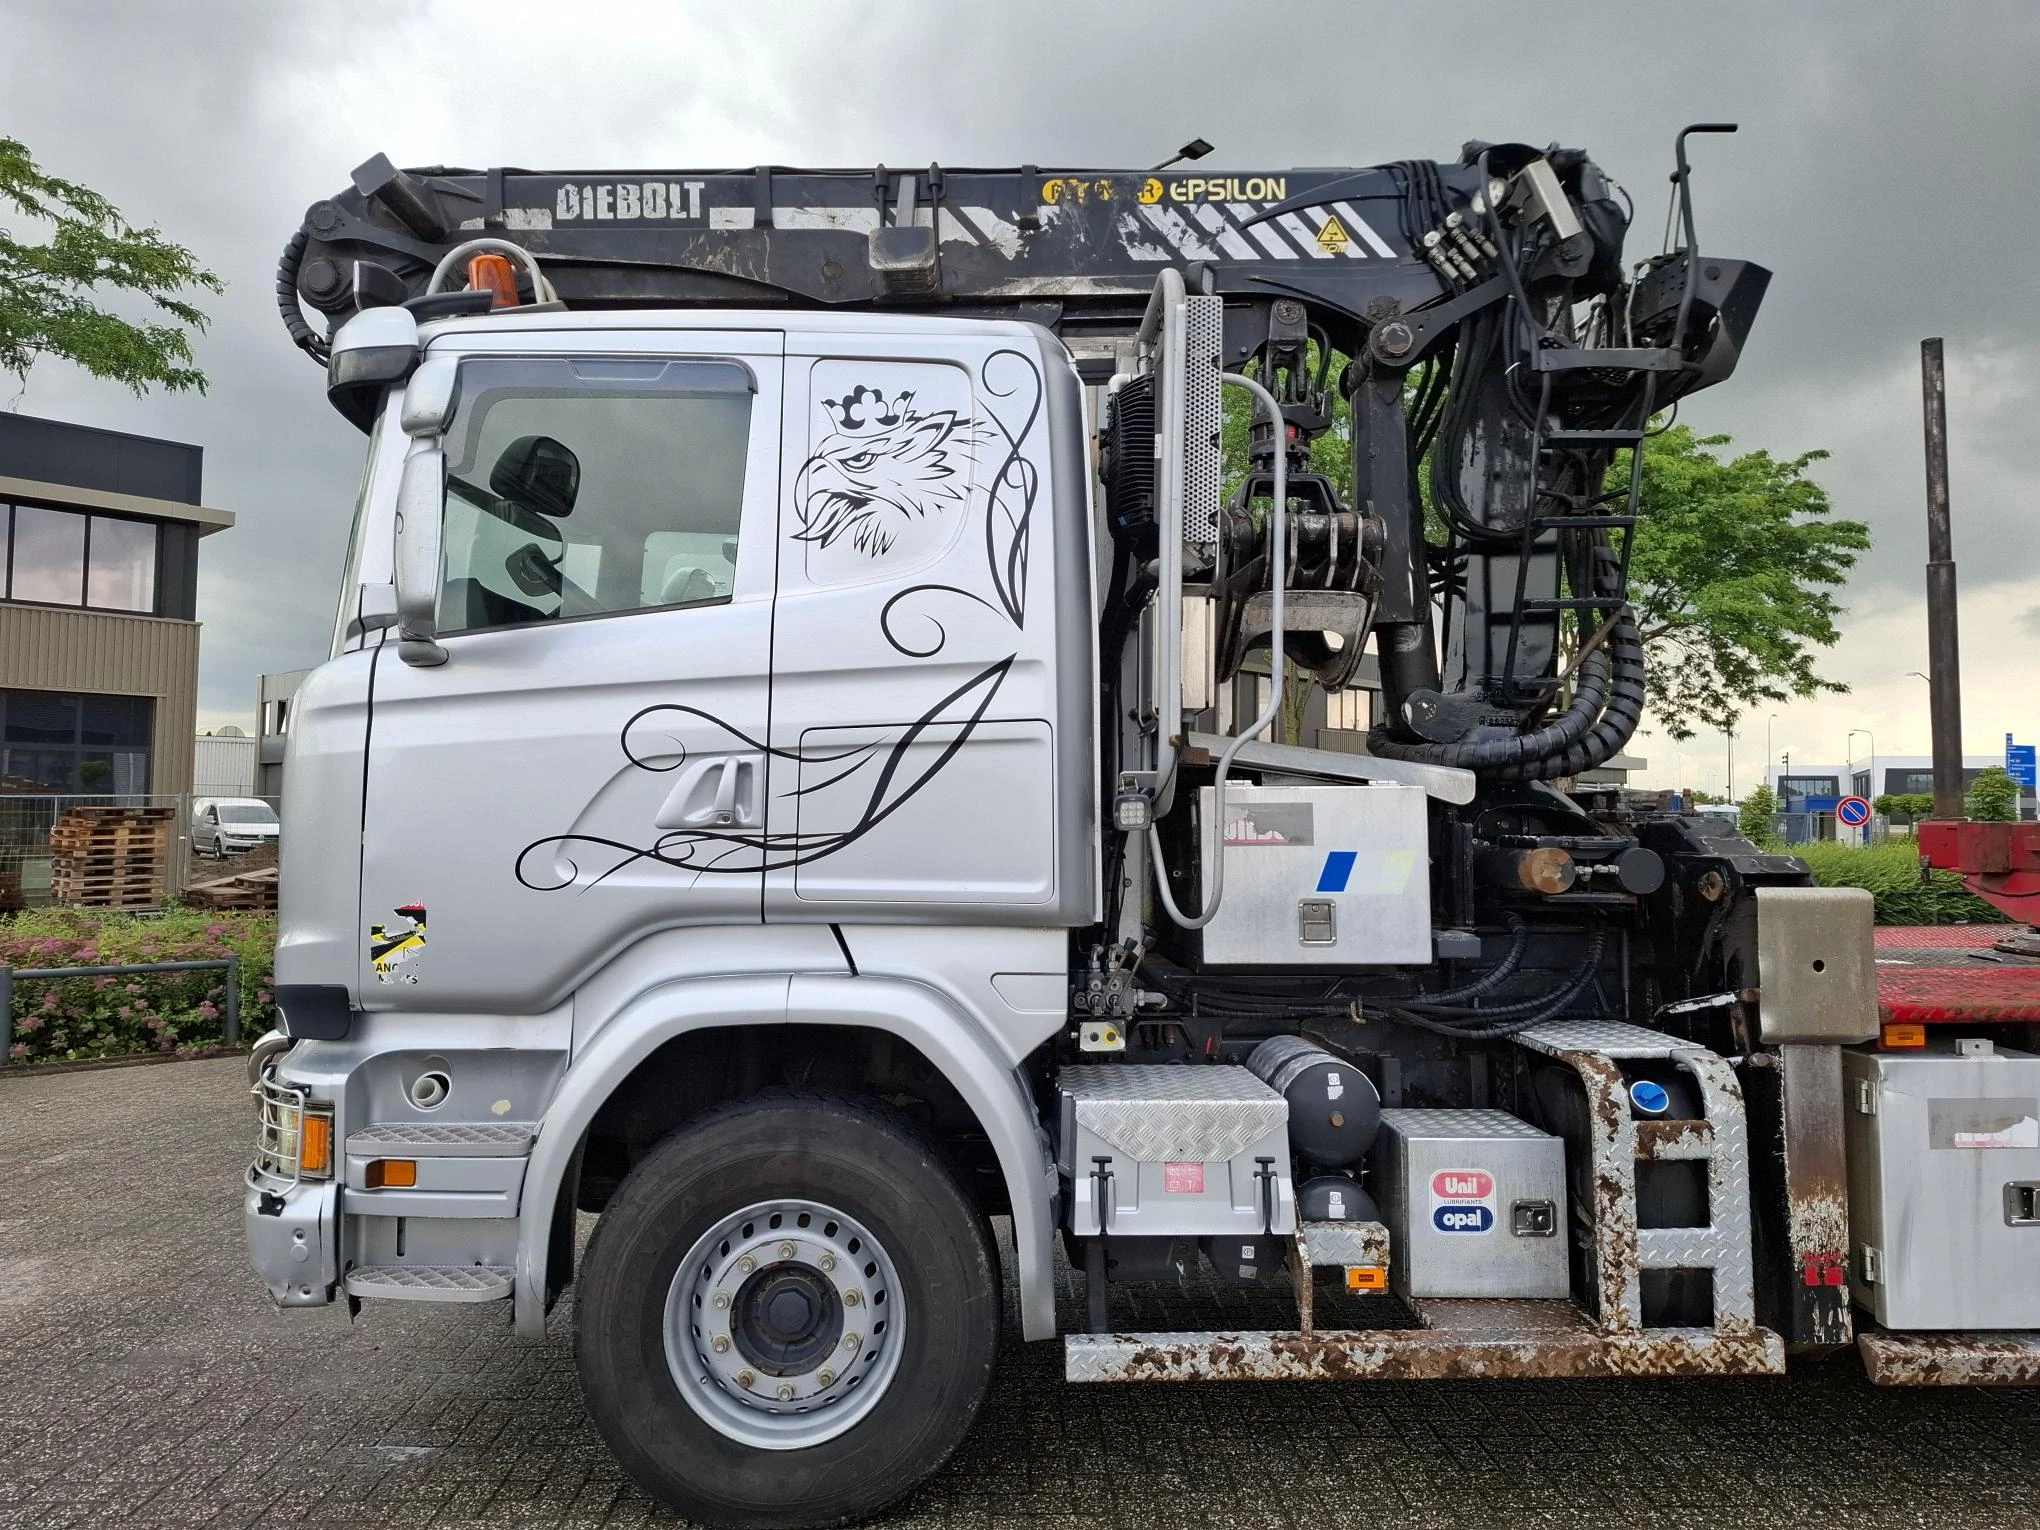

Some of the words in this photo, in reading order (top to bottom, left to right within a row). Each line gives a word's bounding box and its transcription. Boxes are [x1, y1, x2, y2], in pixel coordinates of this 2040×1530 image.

[1170, 177, 1286, 201] EPSILON
[557, 181, 705, 220] DIEBOLT
[1445, 1177, 1478, 1194] Unil
[1443, 1209, 1482, 1230] opal
